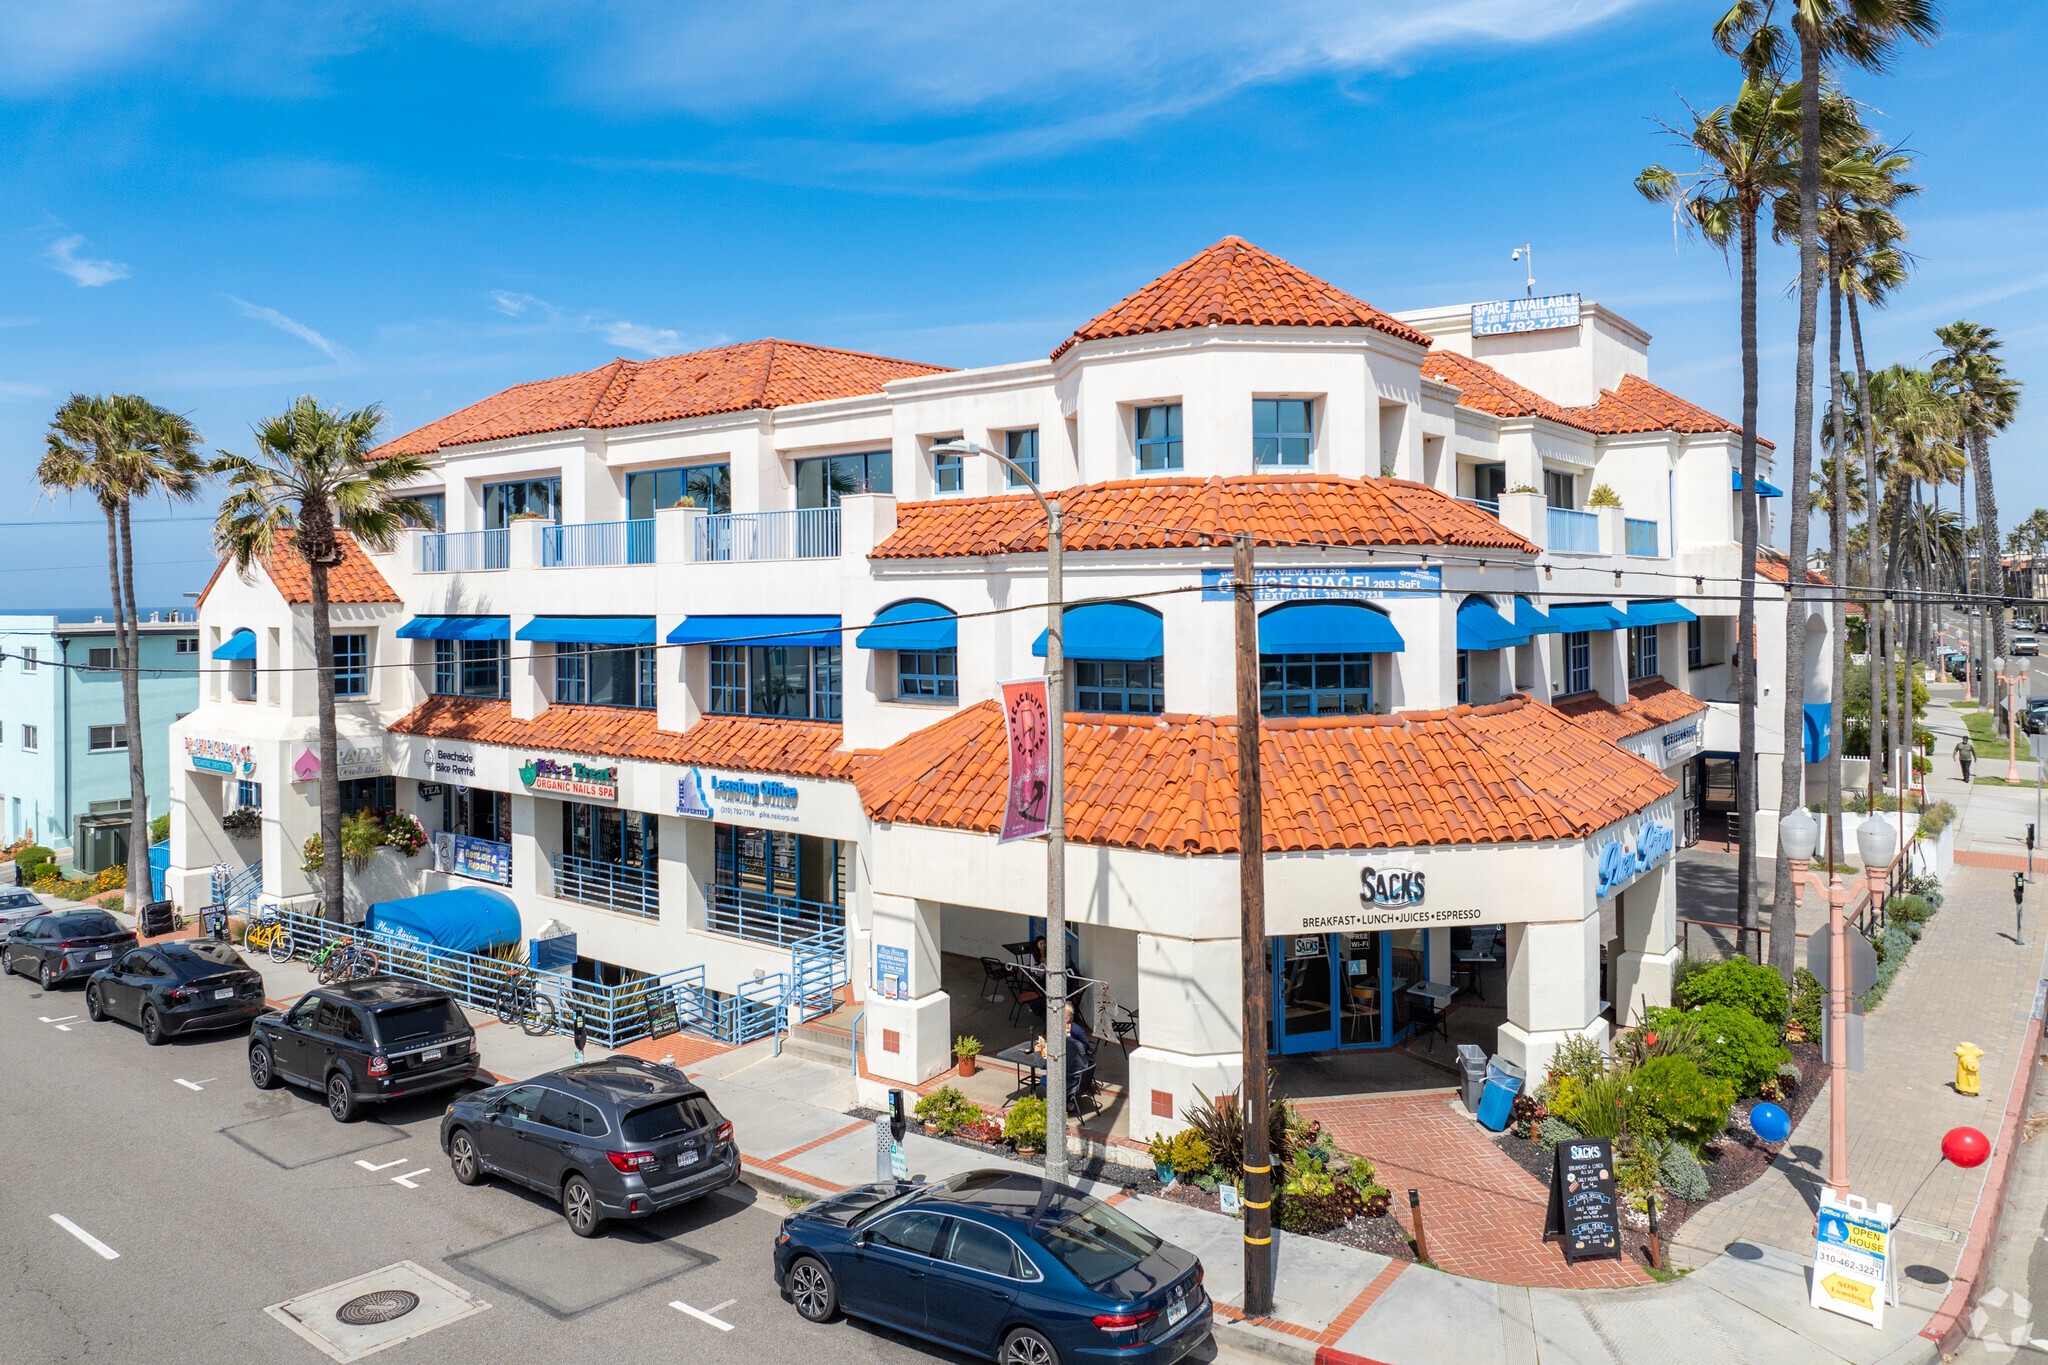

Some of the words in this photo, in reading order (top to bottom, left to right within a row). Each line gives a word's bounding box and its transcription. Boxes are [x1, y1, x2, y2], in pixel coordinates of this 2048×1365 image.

[1474, 302, 1510, 316] SPACE
[1513, 295, 1579, 312] AVAILABLE
[1531, 309, 1548, 319] RETAIL
[1555, 306, 1579, 316] STORAGE
[1474, 316, 1579, 333] 310-792-7238
[1217, 577, 1292, 593] OICE
[1297, 576, 1370, 592] SPACE!
[1373, 580, 1396, 588] 2053
[1325, 591, 1384, 599] 310-792-7238
[1014, 730, 1045, 758] FESTIVAL
[337, 746, 383, 765] PADE
[437, 750, 473, 763] Beachside
[436, 762, 451, 773] Bike
[452, 764, 476, 777] Rental
[423, 785, 440, 795] TEA
[536, 778, 570, 791] ORGANIC
[572, 784, 596, 795] NAILS
[598, 787, 613, 797] SPA
[711, 776, 759, 797] Leasing
[760, 780, 798, 799] Office
[676, 806, 708, 816] PROPERTIES
[468, 860, 495, 873] Repairs
[492, 855, 497, 864] &
[1359, 866, 1425, 903] SACKS
[1302, 915, 1356, 927] BREAKFAST
[1362, 913, 1394, 924] LUNCH
[1399, 911, 1430, 923] JUICES
[1436, 909, 1481, 920] ESPRESSO
[376, 920, 394, 934] Plaza
[1296, 940, 1318, 952] SACKS
[1351, 963, 1359, 973] A
[1571, 1145, 1600, 1160] SACKS
[1821, 1207, 1840, 1218] Office
[1865, 1219, 1885, 1230] Space
[1852, 1227, 1881, 1241] OPEN
[1849, 1237, 1884, 1253] HOUSE
[1819, 1252, 1880, 1277] 310-462-3221
[1837, 1281, 1858, 1292] NOW
